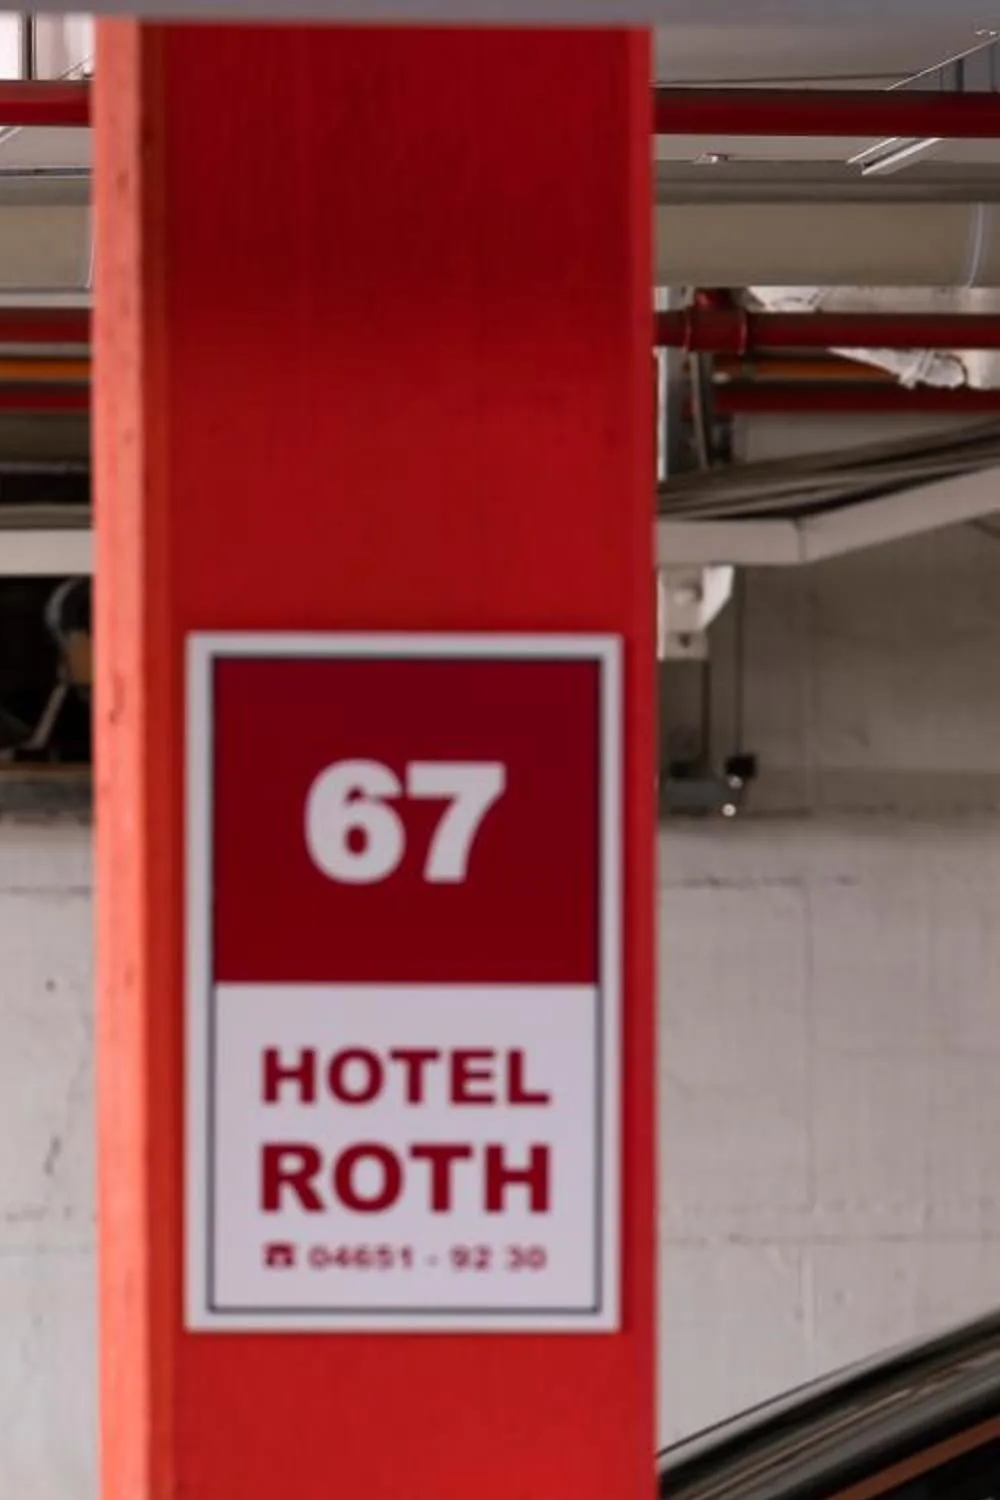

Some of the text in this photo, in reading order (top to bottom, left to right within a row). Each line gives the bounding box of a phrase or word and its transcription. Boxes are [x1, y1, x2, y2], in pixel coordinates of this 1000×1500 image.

[303, 757, 507, 886] 67
[261, 1046, 552, 1107] HOTEL
[259, 1142, 553, 1215] ROTH
[306, 1244, 414, 1270] 04651
[450, 1244, 492, 1271] 92
[506, 1244, 549, 1271] 30
